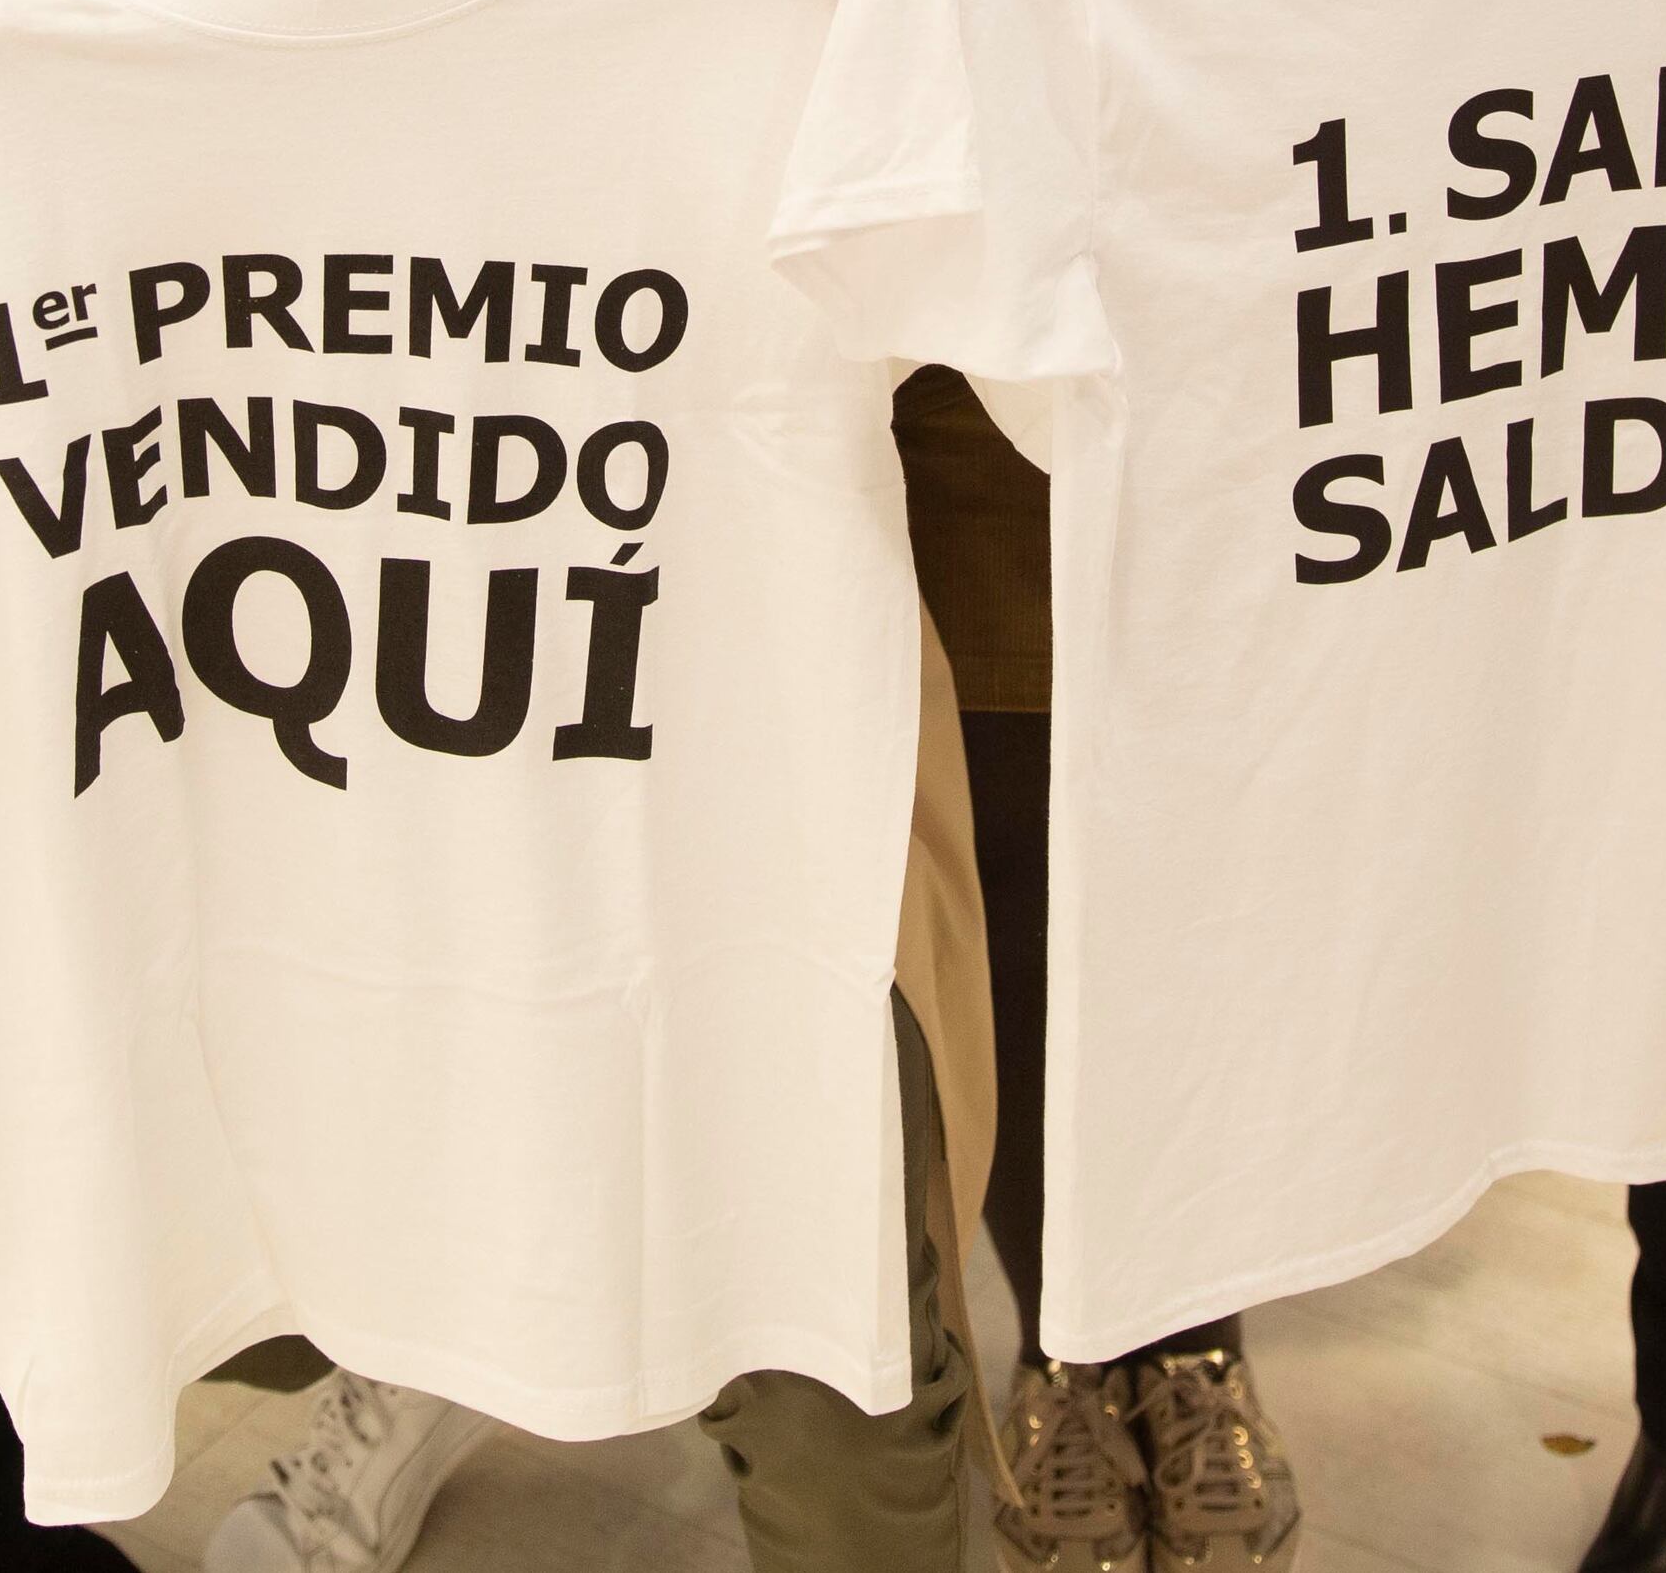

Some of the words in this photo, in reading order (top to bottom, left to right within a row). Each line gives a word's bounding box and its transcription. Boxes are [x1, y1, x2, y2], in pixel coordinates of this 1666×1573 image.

[1292, 117, 1408, 254] 1.
[128, 252, 691, 374] PREMIO
[73, 535, 661, 801] AQUÍ
